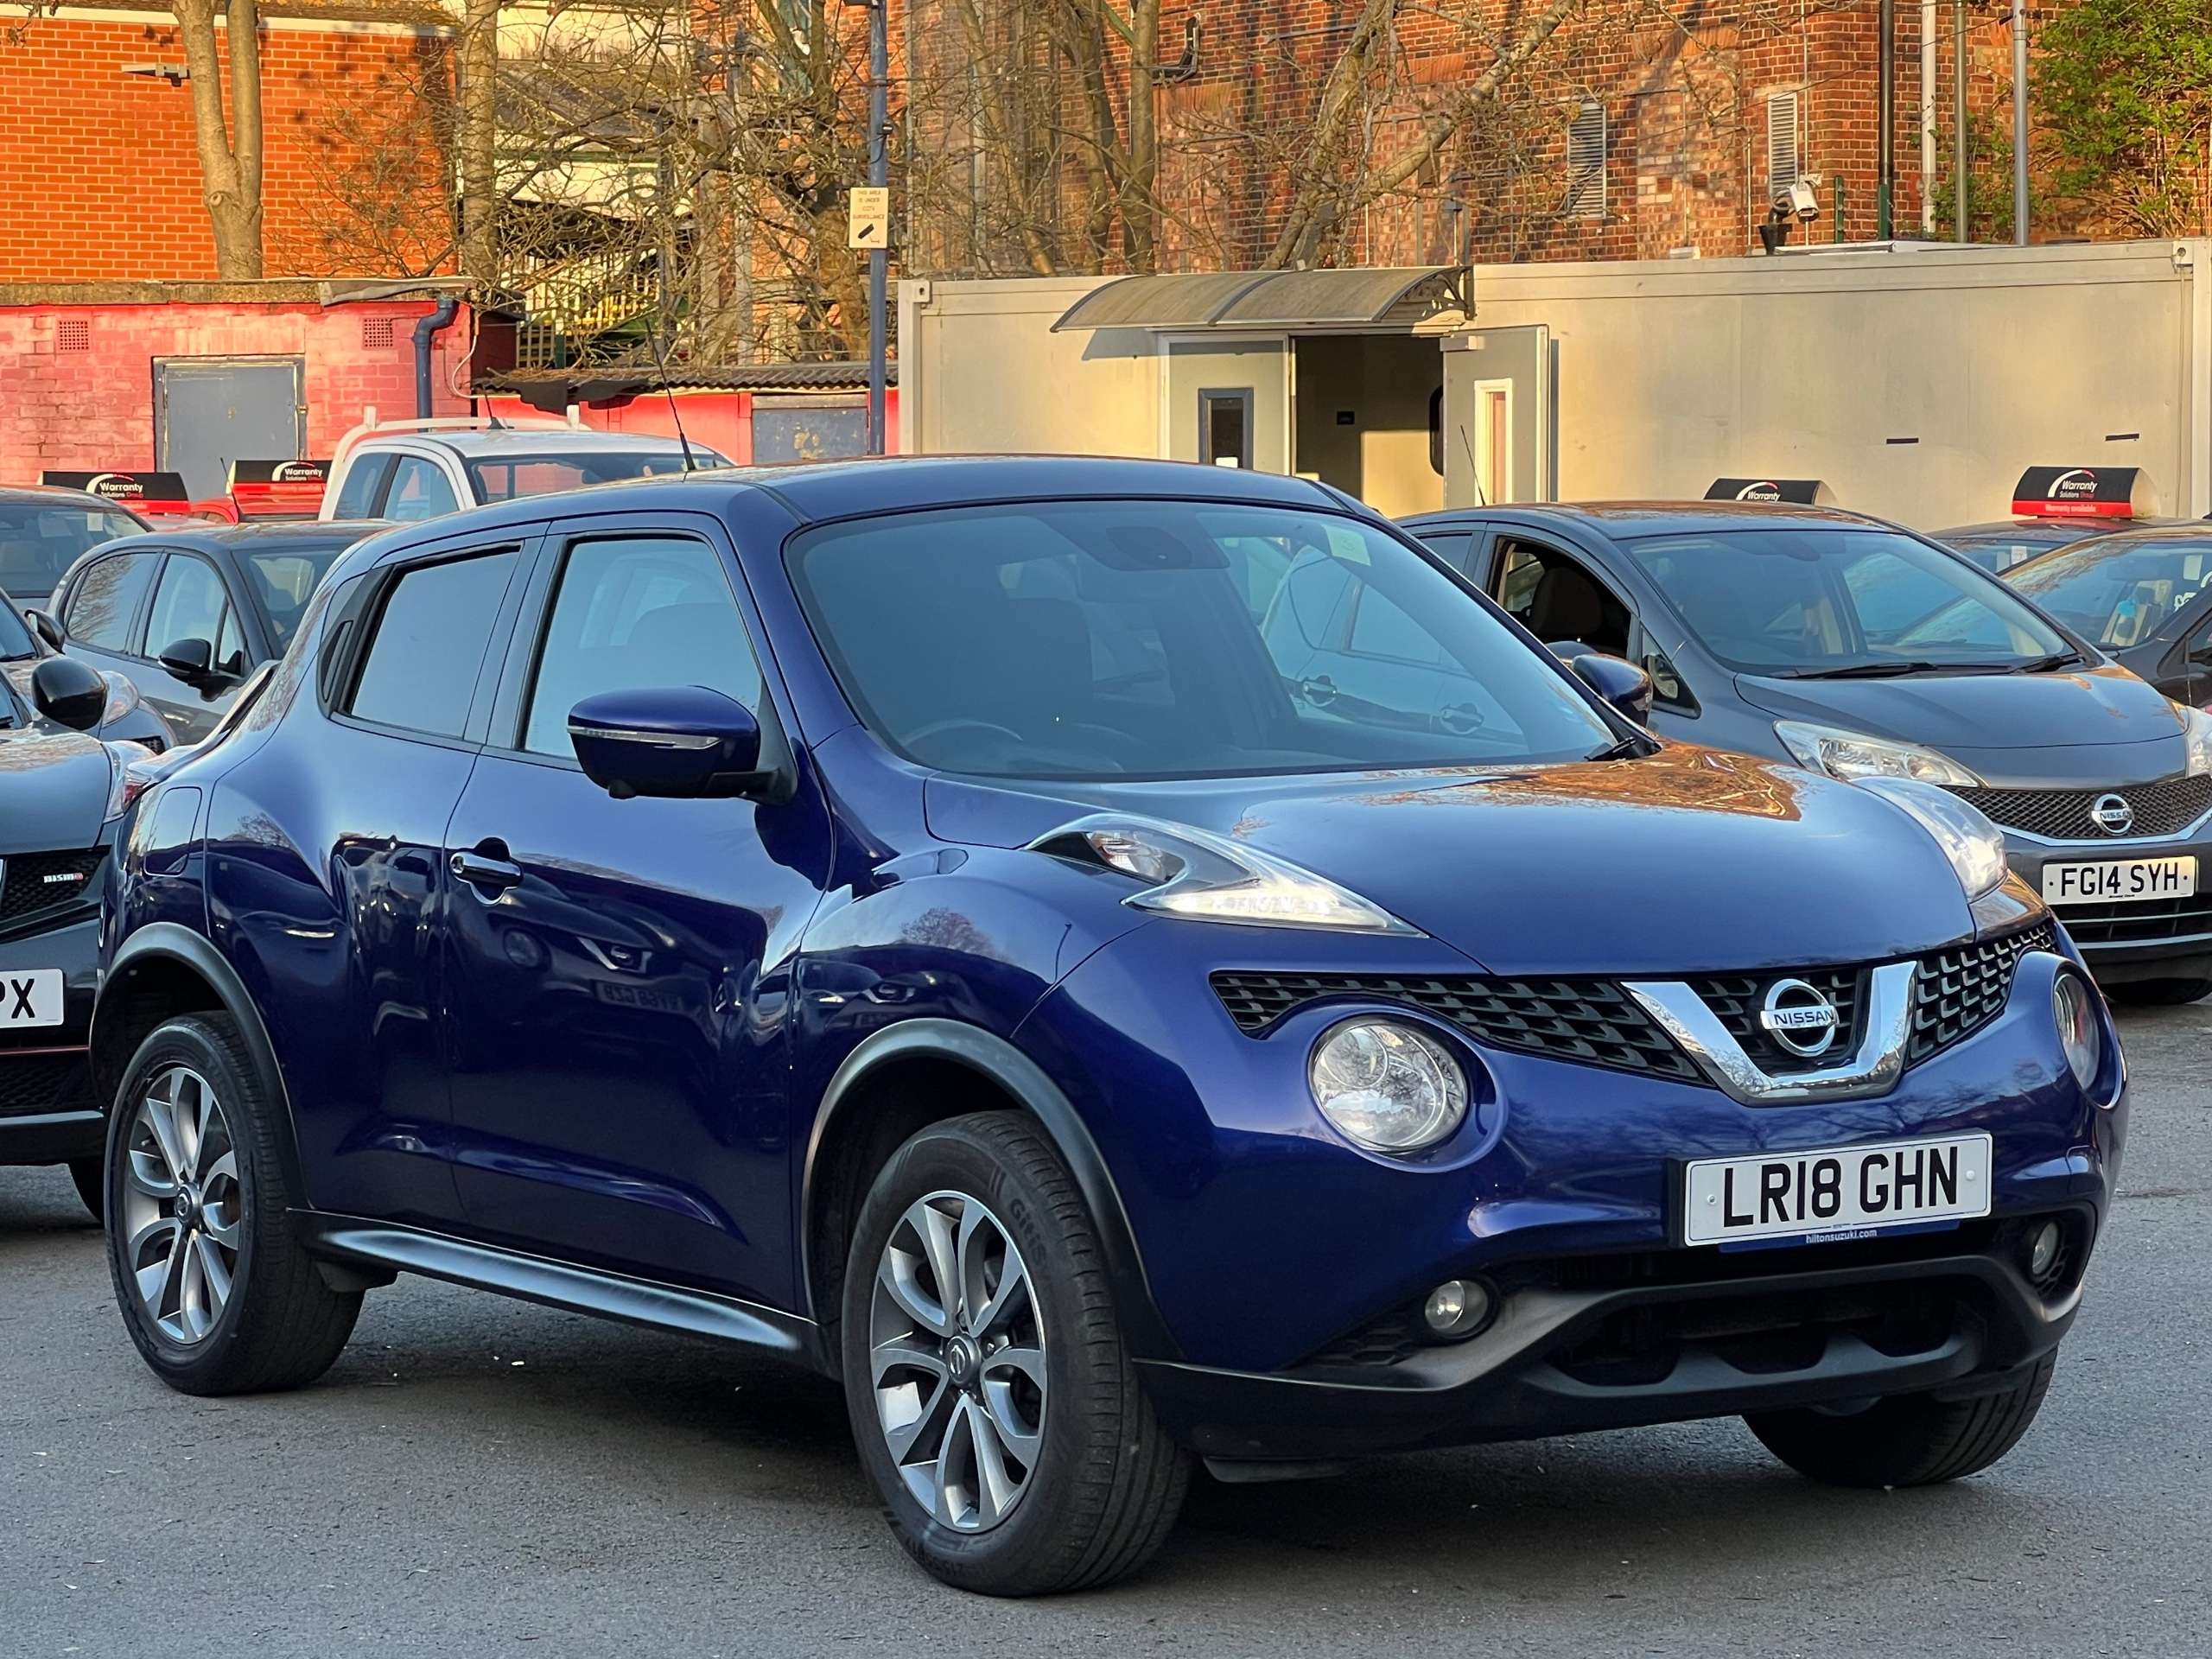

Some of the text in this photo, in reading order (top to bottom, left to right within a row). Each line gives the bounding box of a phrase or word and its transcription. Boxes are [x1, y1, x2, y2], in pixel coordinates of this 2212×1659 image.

[284, 467, 323, 478] Warranty
[99, 482, 143, 493] Warranty
[2062, 480, 2098, 493] Warranty
[1746, 491, 1781, 501] Warranty
[2061, 862, 2178, 897] FG14 SYH
[0, 978, 35, 1019] X
[1774, 1010, 1834, 1026] NISSAN
[1723, 1147, 1958, 1228] LR18 GHN
[1806, 1230, 1878, 1243] hiltonsuzuki.com
